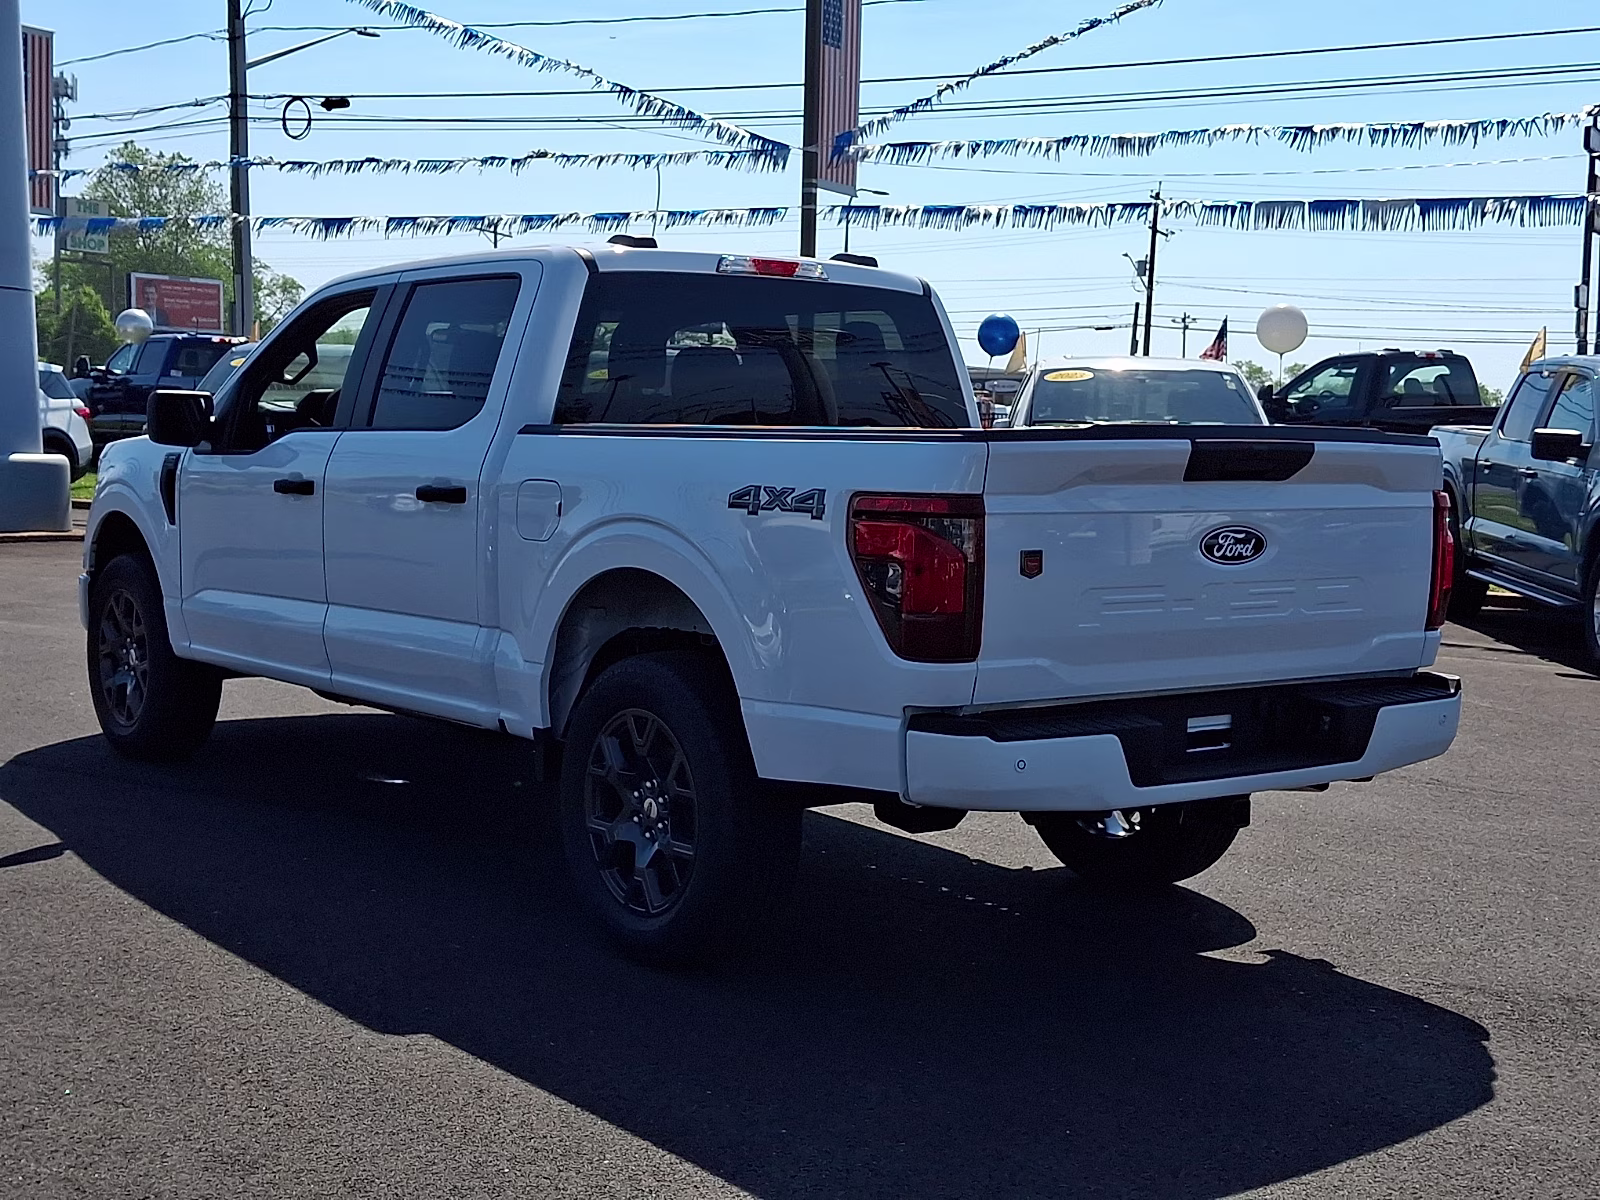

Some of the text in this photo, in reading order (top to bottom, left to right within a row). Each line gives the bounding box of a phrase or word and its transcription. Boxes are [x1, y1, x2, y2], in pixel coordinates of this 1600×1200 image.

[76, 200, 99, 214] THE
[70, 234, 105, 250] SHOP
[1213, 532, 1256, 557] Ford
